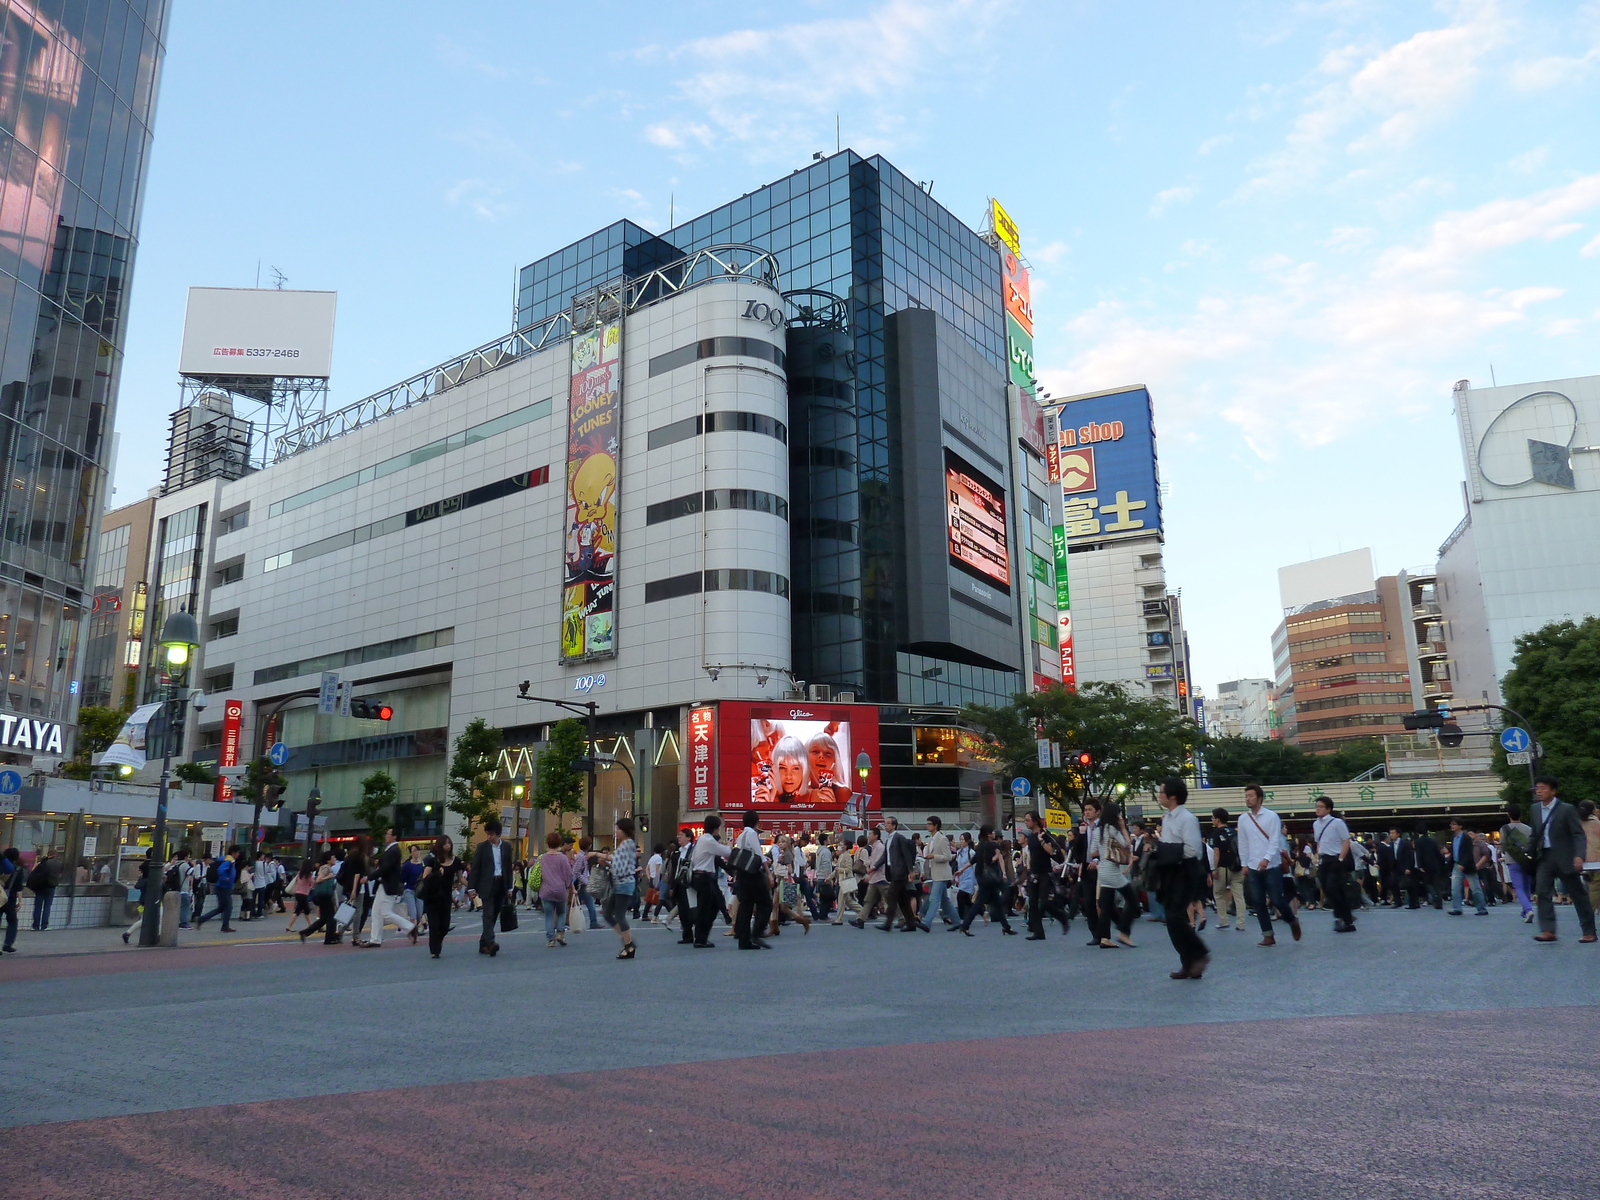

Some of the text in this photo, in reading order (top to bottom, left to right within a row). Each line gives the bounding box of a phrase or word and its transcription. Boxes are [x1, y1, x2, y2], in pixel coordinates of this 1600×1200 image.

[213, 348, 300, 358] 広告募集 5337-2468
[571, 390, 615, 425] LOONEY
[577, 409, 613, 438] TUNES
[1078, 420, 1124, 444] shop
[1049, 450, 1059, 481] アイフル
[1063, 490, 1147, 538] 富士
[1054, 532, 1065, 559] レイク
[578, 598, 598, 620] WHAT
[1061, 647, 1074, 676] アコム
[692, 711, 712, 722] 名物
[789, 709, 815, 720] Glico
[694, 724, 709, 805] 天津甘栗
[1307, 782, 1430, 804] 渋谷駅
